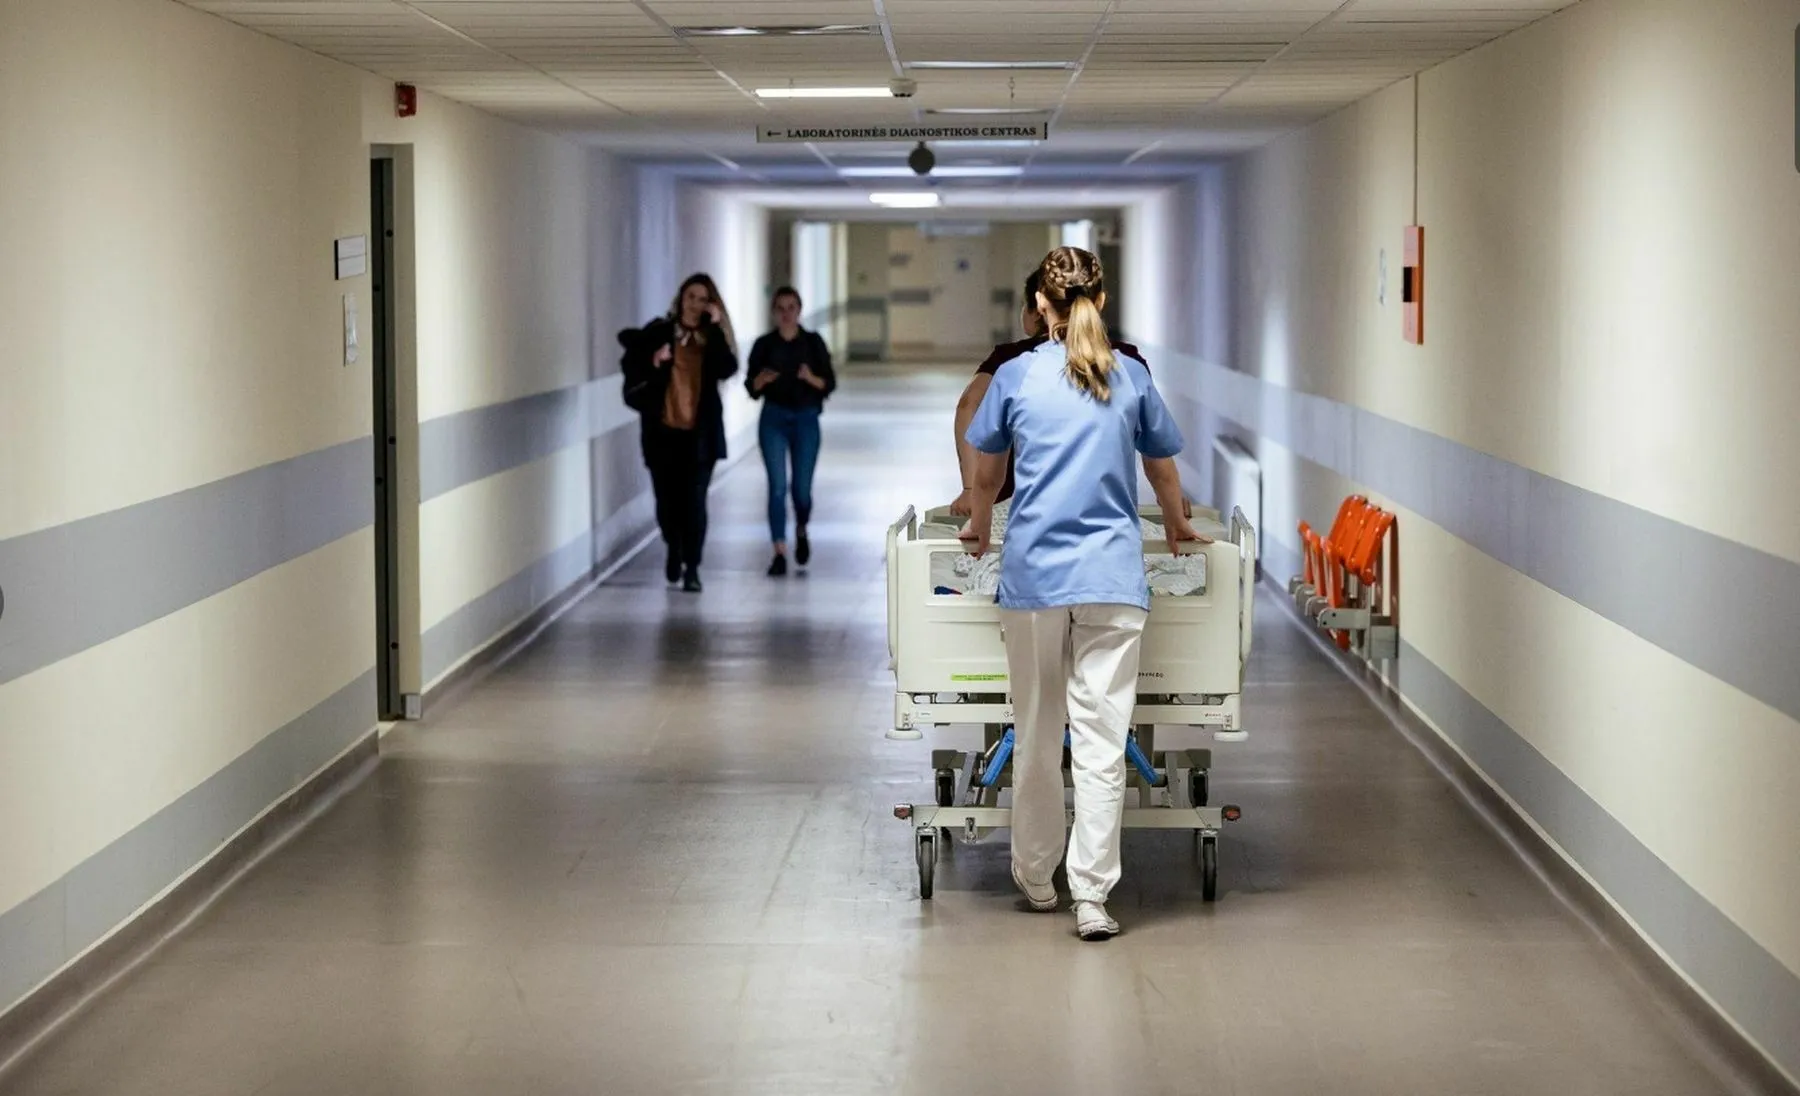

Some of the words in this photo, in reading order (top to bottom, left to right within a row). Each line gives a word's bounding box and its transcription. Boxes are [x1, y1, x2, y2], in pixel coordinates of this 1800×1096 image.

[787, 126, 887, 138] LABORATORINĖS
[890, 127, 978, 137] DIAGNOSTIKOS
[981, 126, 1037, 136] CENTRAS
